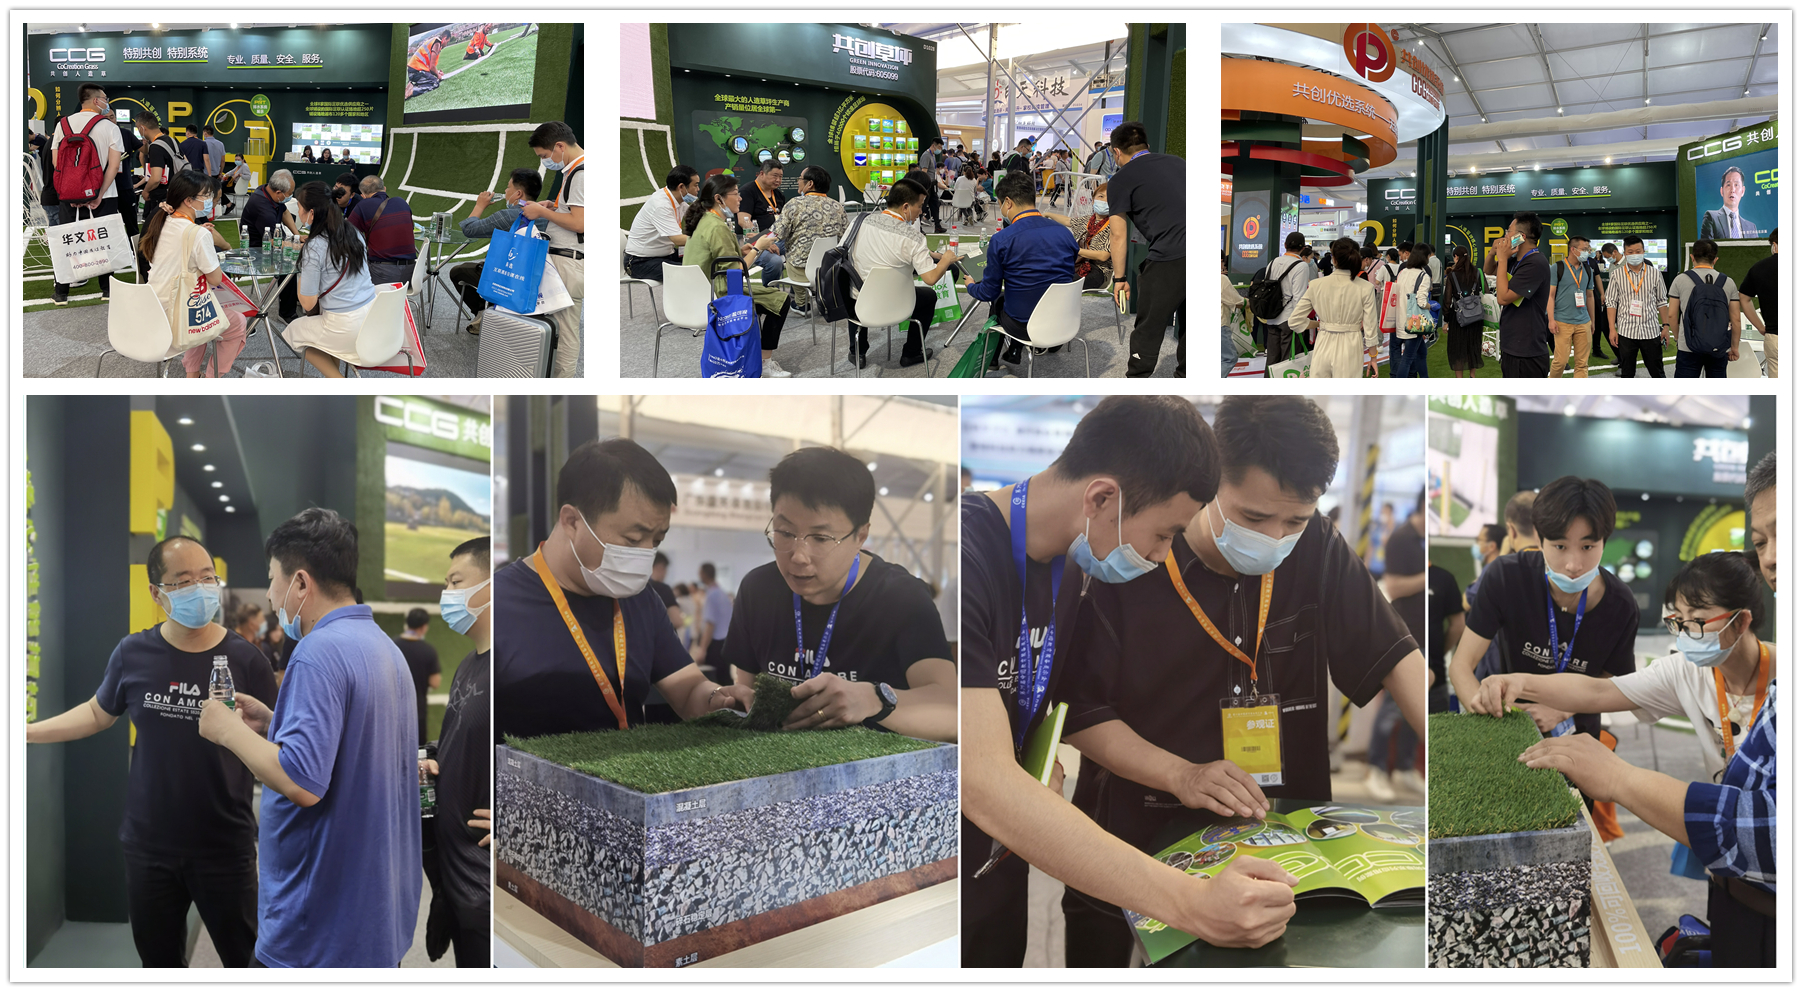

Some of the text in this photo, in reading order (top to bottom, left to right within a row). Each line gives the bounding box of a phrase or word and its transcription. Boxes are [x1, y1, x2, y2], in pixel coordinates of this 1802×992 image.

[49, 47, 106, 62] CCG
[123, 46, 209, 59] 特别共创 特别系统
[832, 33, 913, 65] 共创草坪
[849, 57, 899, 71] GREEN INNOVATION
[1687, 136, 1743, 161] CCG
[1482, 183, 1516, 195] 特别系统
[62, 227, 109, 245] 华文众合
[200, 319, 220, 332] balance
[374, 395, 460, 440] CCG
[1524, 641, 1550, 657] CON
[768, 661, 797, 677] CON
[169, 682, 201, 696] FILA
[145, 692, 171, 704] CON
[1246, 719, 1276, 730] 参观证
[676, 799, 707, 812] 混凝土层
[675, 952, 699, 968] 素土层
